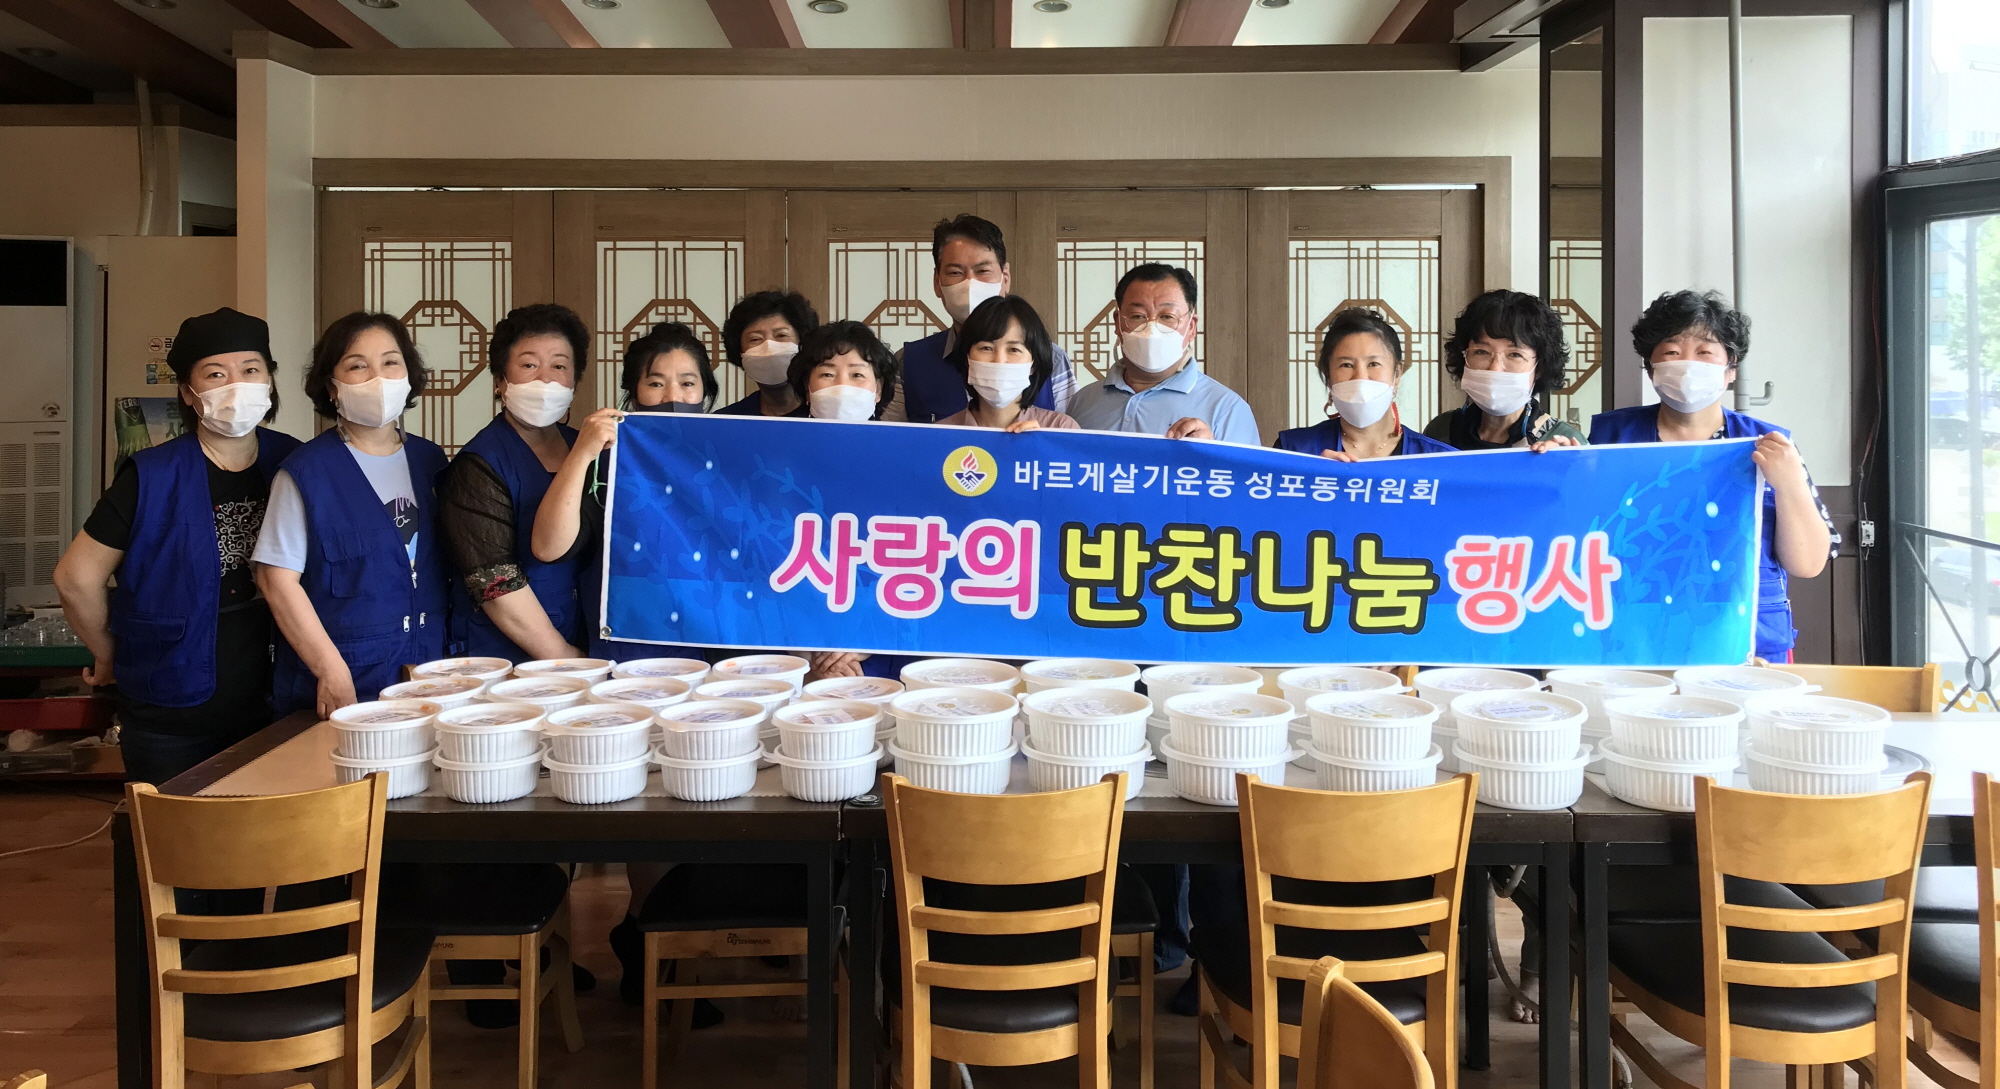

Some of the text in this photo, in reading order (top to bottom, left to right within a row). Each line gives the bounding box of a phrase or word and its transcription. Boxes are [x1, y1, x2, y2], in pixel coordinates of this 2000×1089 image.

[117, 398, 141, 410] TERR
[1014, 460, 1440, 505] 바르게살기운동 성포동위원회
[772, 515, 1619, 632] 사랑의 반찬나눔 행사
